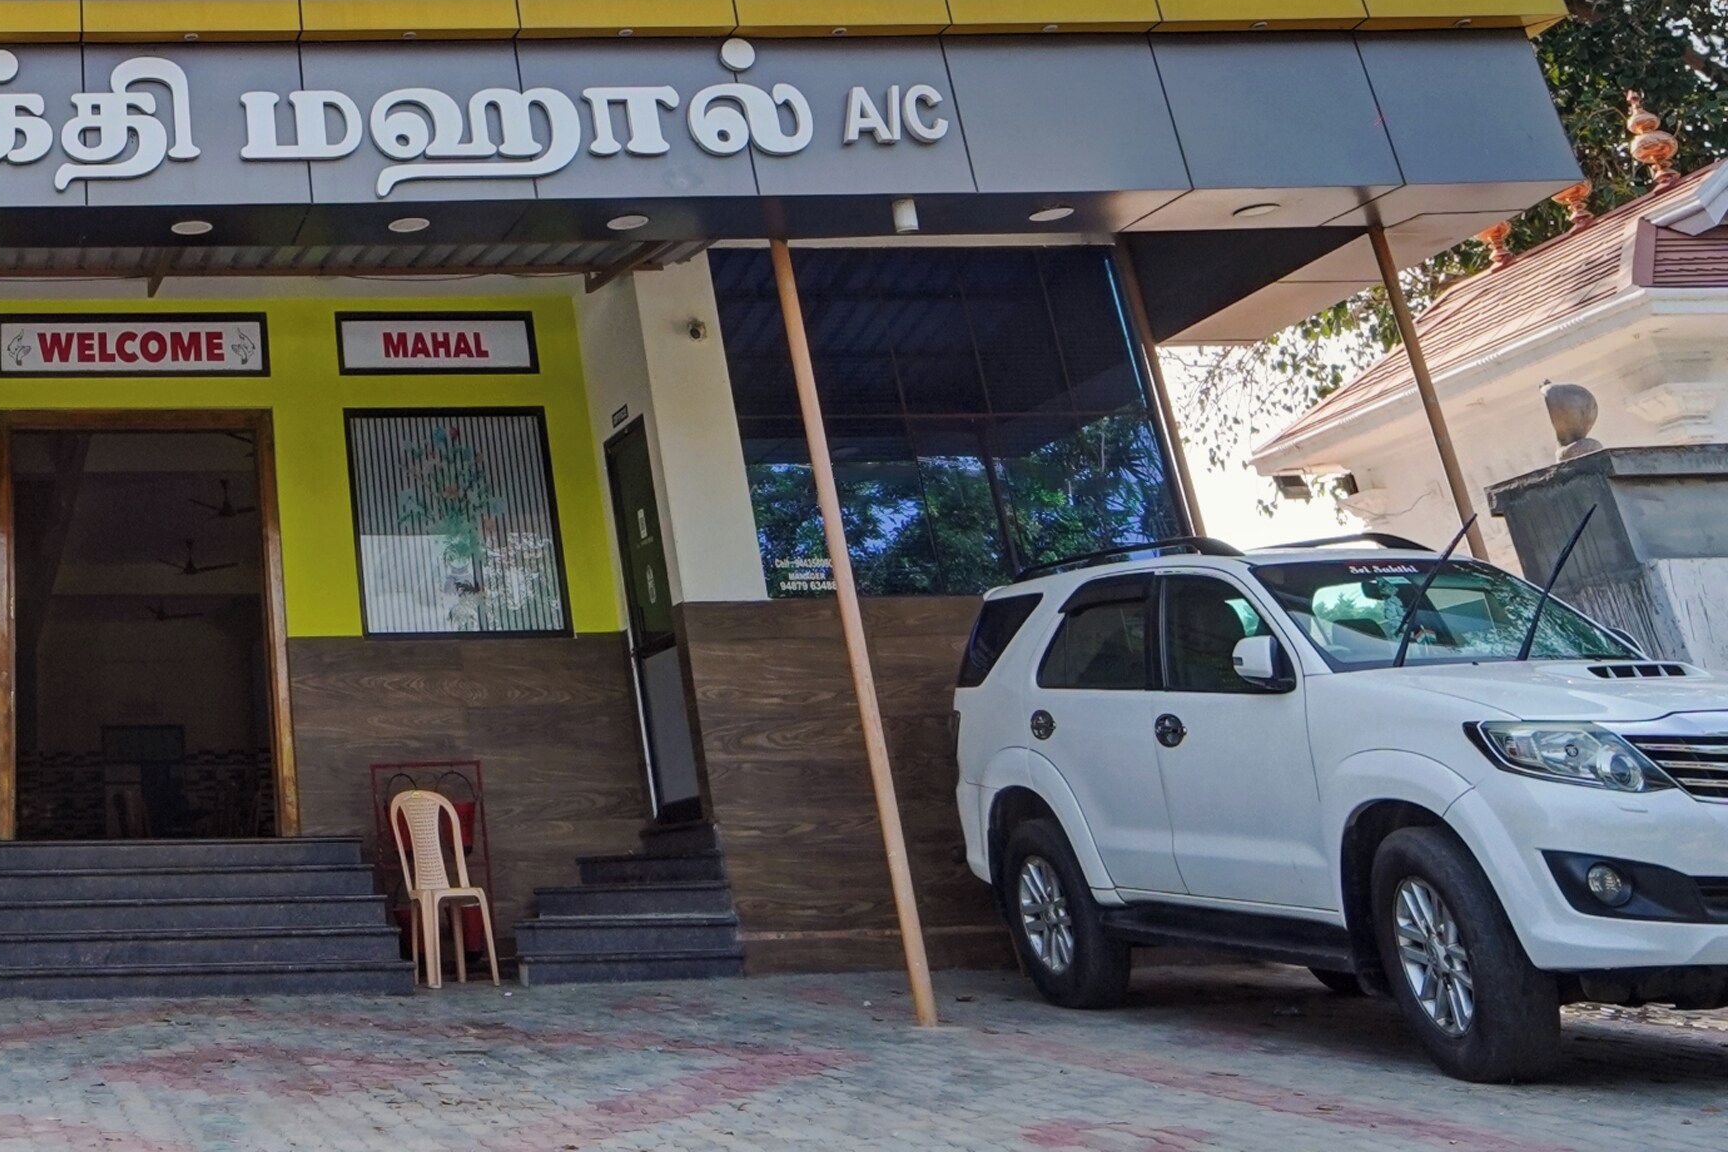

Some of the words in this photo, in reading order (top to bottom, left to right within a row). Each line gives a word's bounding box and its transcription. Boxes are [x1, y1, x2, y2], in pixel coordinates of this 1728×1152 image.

[240, 38, 813, 199] மஹால்
[37, 331, 225, 363] WELCOME
[382, 332, 490, 359] MAHAL
